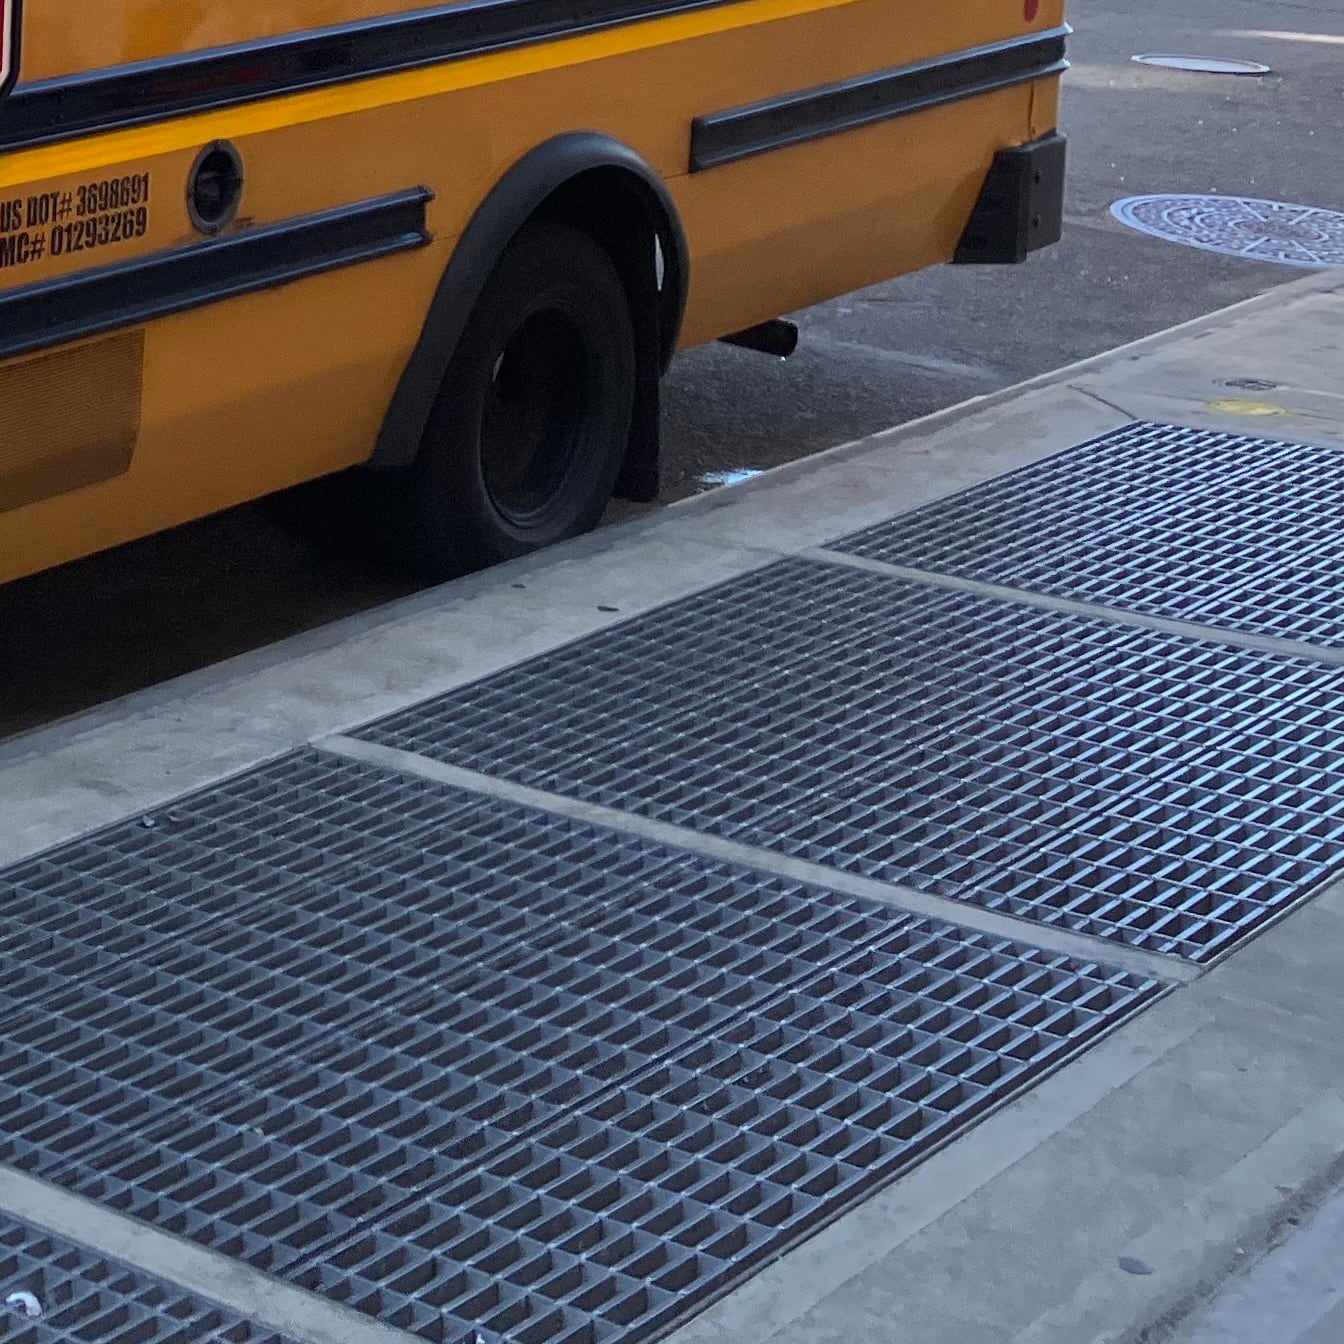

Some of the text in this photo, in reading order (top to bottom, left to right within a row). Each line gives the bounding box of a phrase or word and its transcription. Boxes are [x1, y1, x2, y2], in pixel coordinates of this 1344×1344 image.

[0, 172, 150, 233] US DOT# 3698691
[50, 206, 148, 256] 01293269
